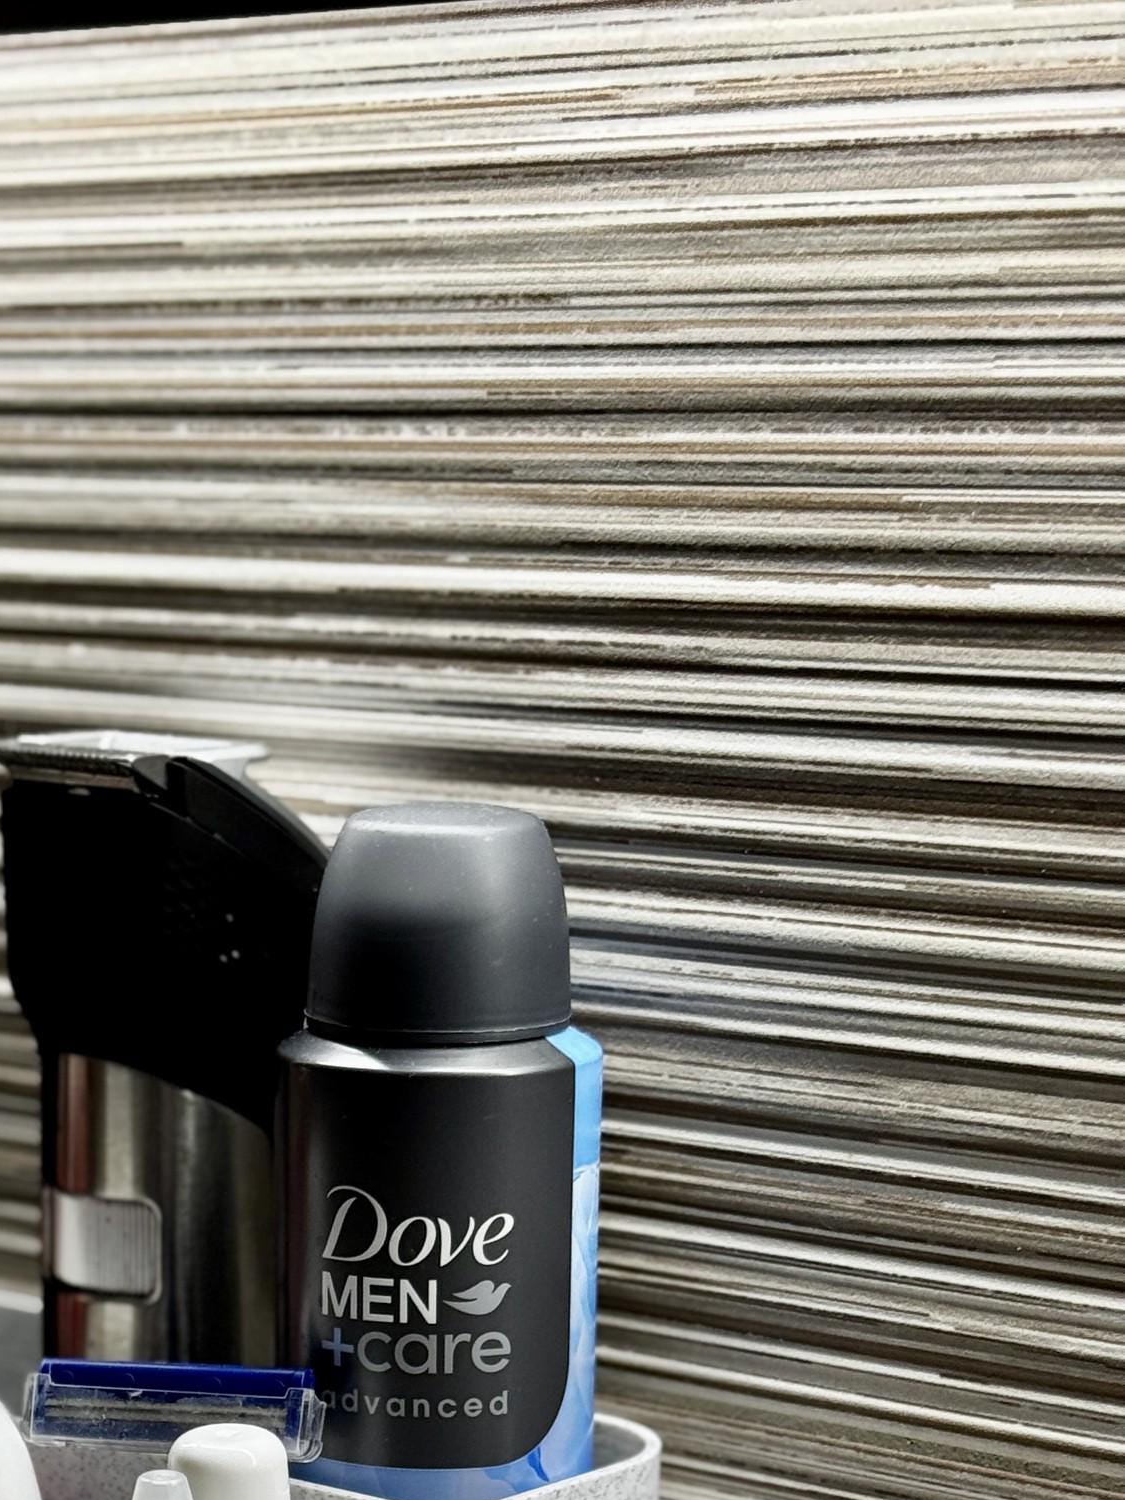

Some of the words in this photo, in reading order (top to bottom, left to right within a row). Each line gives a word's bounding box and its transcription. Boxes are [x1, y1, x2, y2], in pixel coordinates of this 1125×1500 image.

[322, 1185, 515, 1267] Dove
[321, 1271, 438, 1325] MEN
[321, 1328, 512, 1375] +care
[324, 1390, 509, 1419] advanced
